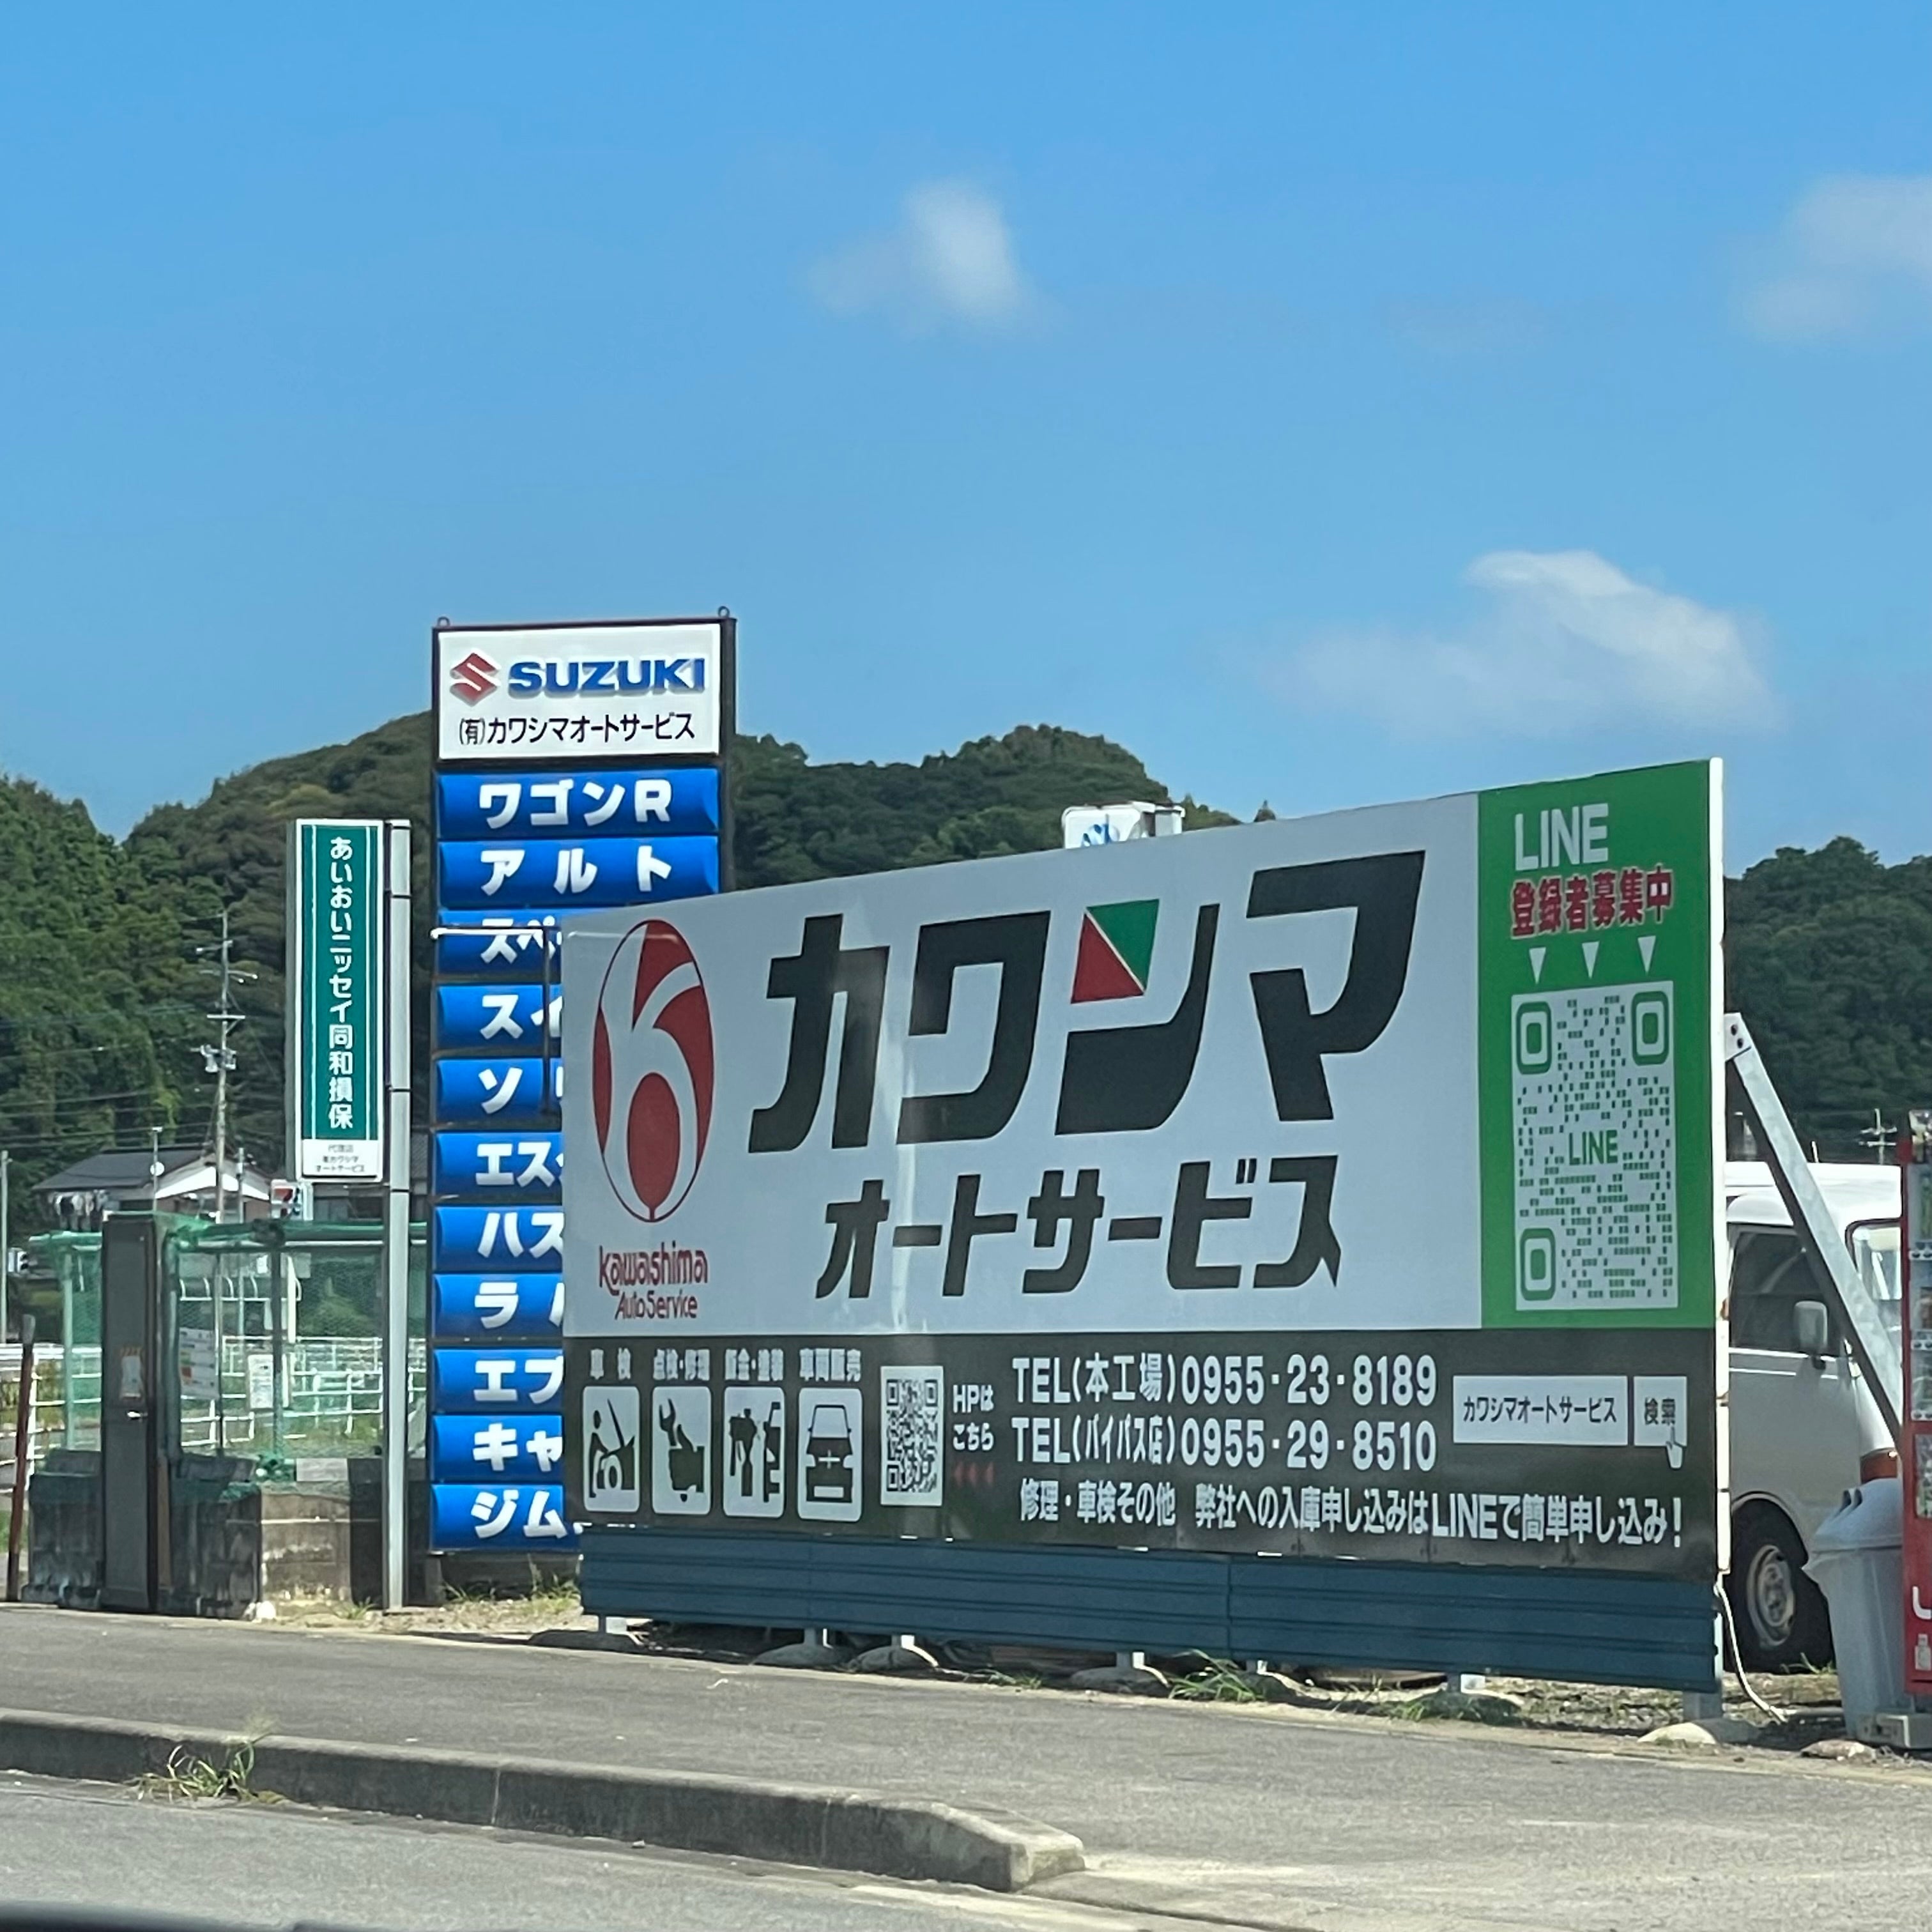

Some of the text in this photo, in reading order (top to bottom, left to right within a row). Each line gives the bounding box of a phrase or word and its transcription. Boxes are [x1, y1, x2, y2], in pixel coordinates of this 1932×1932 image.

[509, 658, 705, 698] SUZUKI
[459, 712, 696, 746] (有)カワシマオートサービス
[479, 779, 672, 829] ワゴンR
[1515, 802, 1609, 871] LINE
[480, 845, 672, 896] アルト
[1510, 862, 1673, 939] 登録者募集中
[328, 837, 353, 1130] あいおいニッセイ同和損保
[749, 850, 1426, 1153] カワシマ
[1569, 1130, 1619, 1166] LINE
[816, 1155, 1342, 1298] オートサービス
[953, 1384, 994, 1413] HPは
[1463, 1395, 1617, 1424] カワシマオートサービス
[953, 1422, 994, 1452] こちら
[1020, 1478, 1176, 1527] 修理・車検その他
